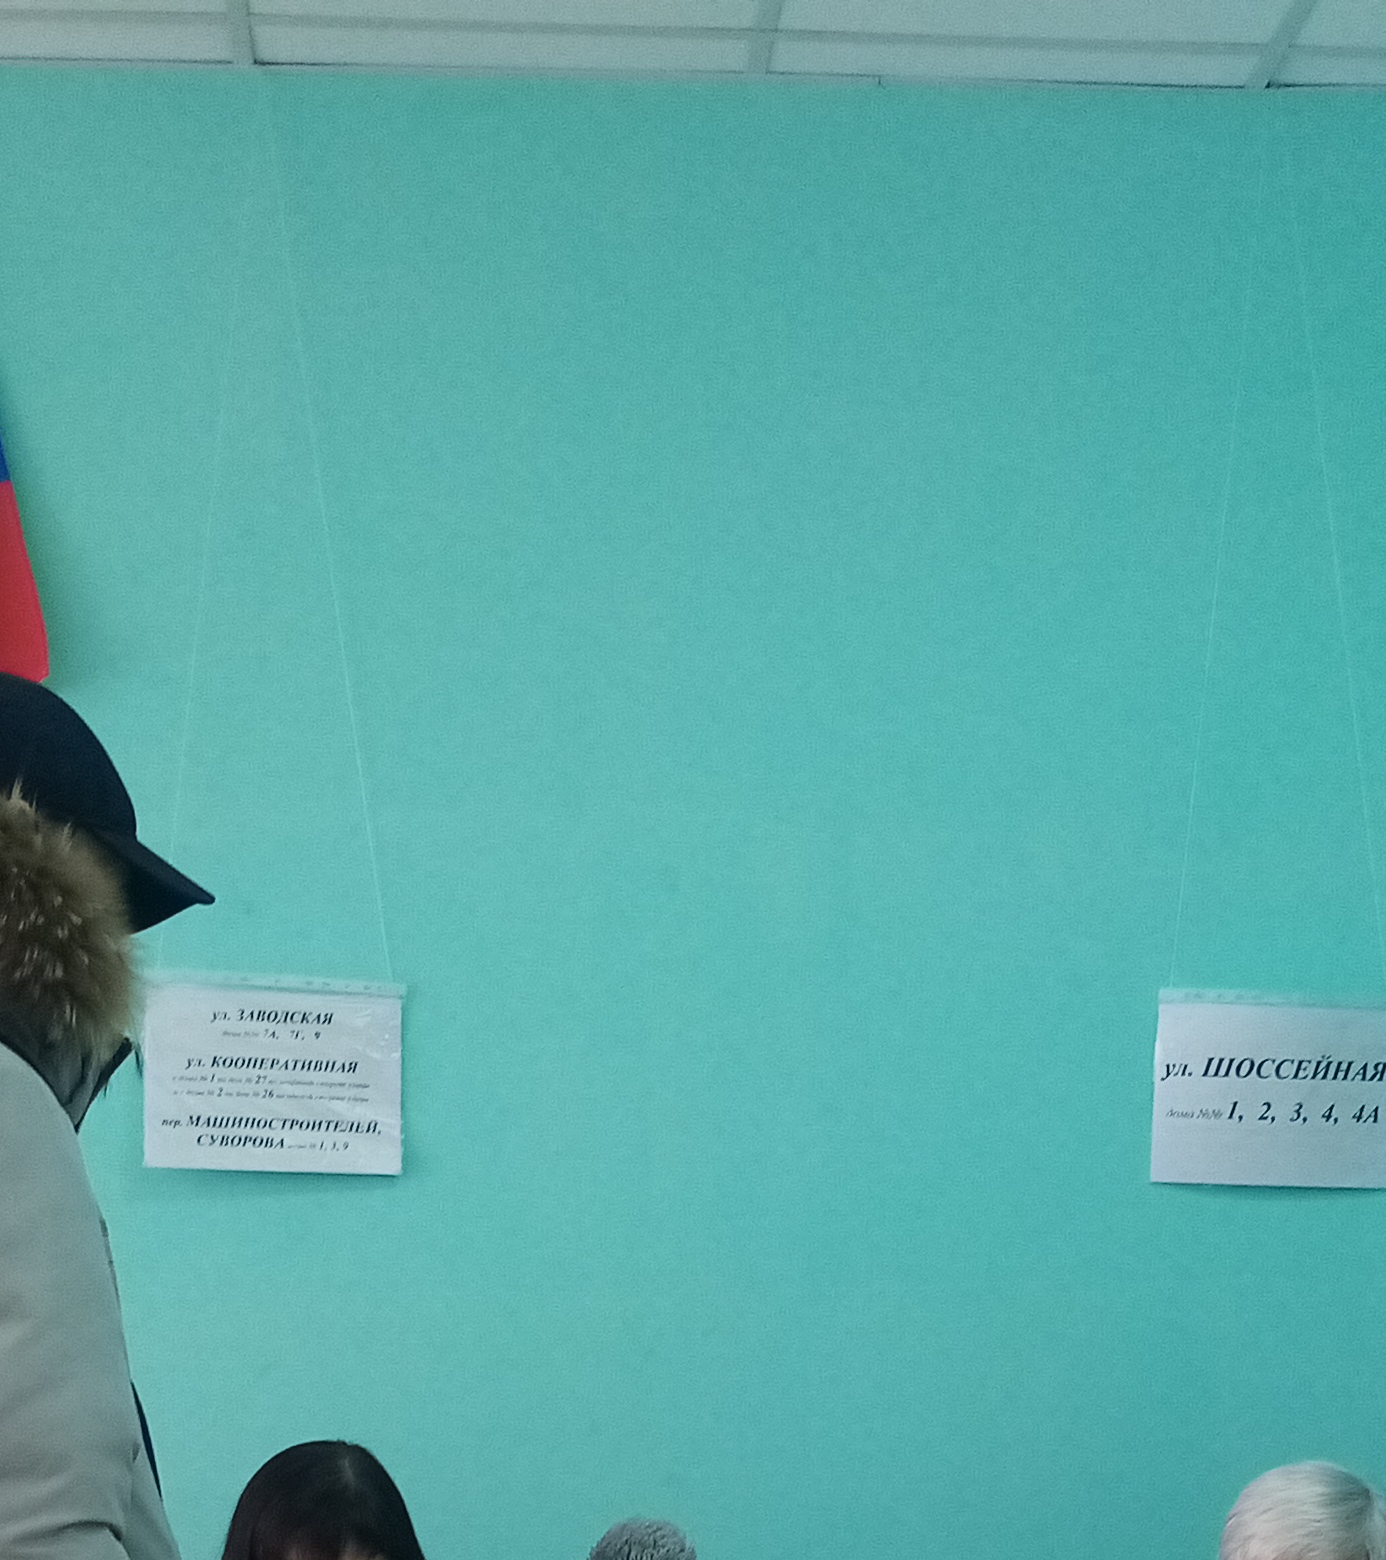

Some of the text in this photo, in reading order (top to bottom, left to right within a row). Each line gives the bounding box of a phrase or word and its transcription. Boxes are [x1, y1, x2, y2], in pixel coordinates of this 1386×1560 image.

[210, 1008, 334, 1026] ул. ЗАВОДСКАЯ
[210, 1055, 359, 1074] КООПЕРАТИВНАЯ
[1160, 1060, 1193, 1082] ул.
[1225, 1100, 1244, 1123] 1,
[1257, 1101, 1277, 1125] 2,
[1289, 1102, 1308, 1126] 3,
[1321, 1103, 1339, 1126] 4,
[1351, 1104, 1381, 1124] 4А
[186, 1114, 382, 1136] МАШИНОСТРОИТЕЛЕЙ,
[196, 1133, 286, 1149] СУВОРОВА
